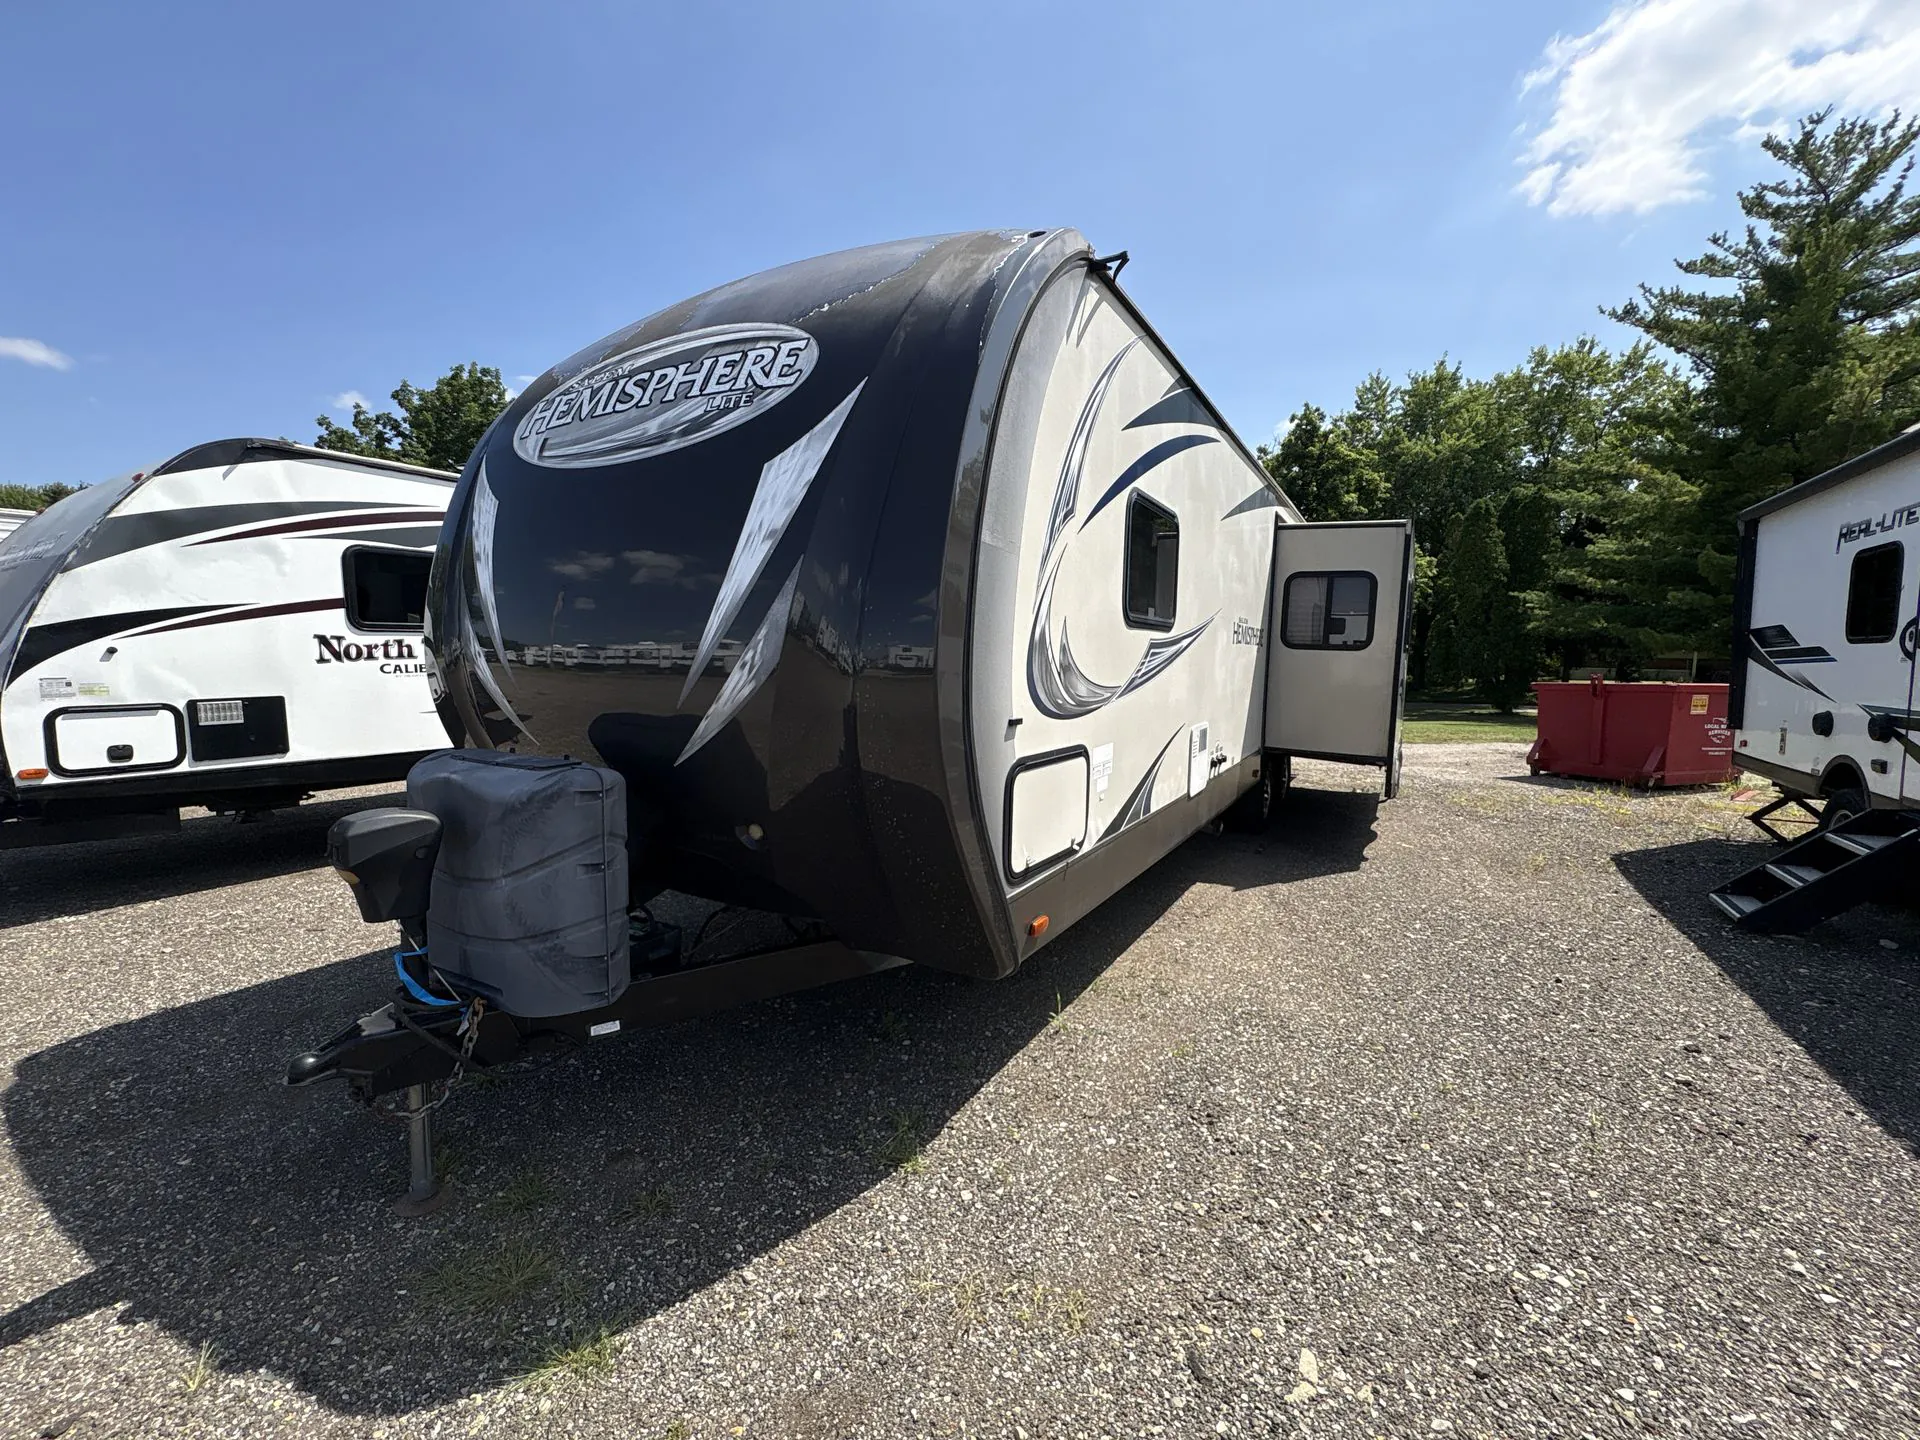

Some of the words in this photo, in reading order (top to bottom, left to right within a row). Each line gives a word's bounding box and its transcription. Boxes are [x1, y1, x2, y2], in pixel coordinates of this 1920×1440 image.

[520, 338, 811, 440] HEMISPHERE
[704, 393, 754, 413] LITE
[312, 634, 418, 664] North
